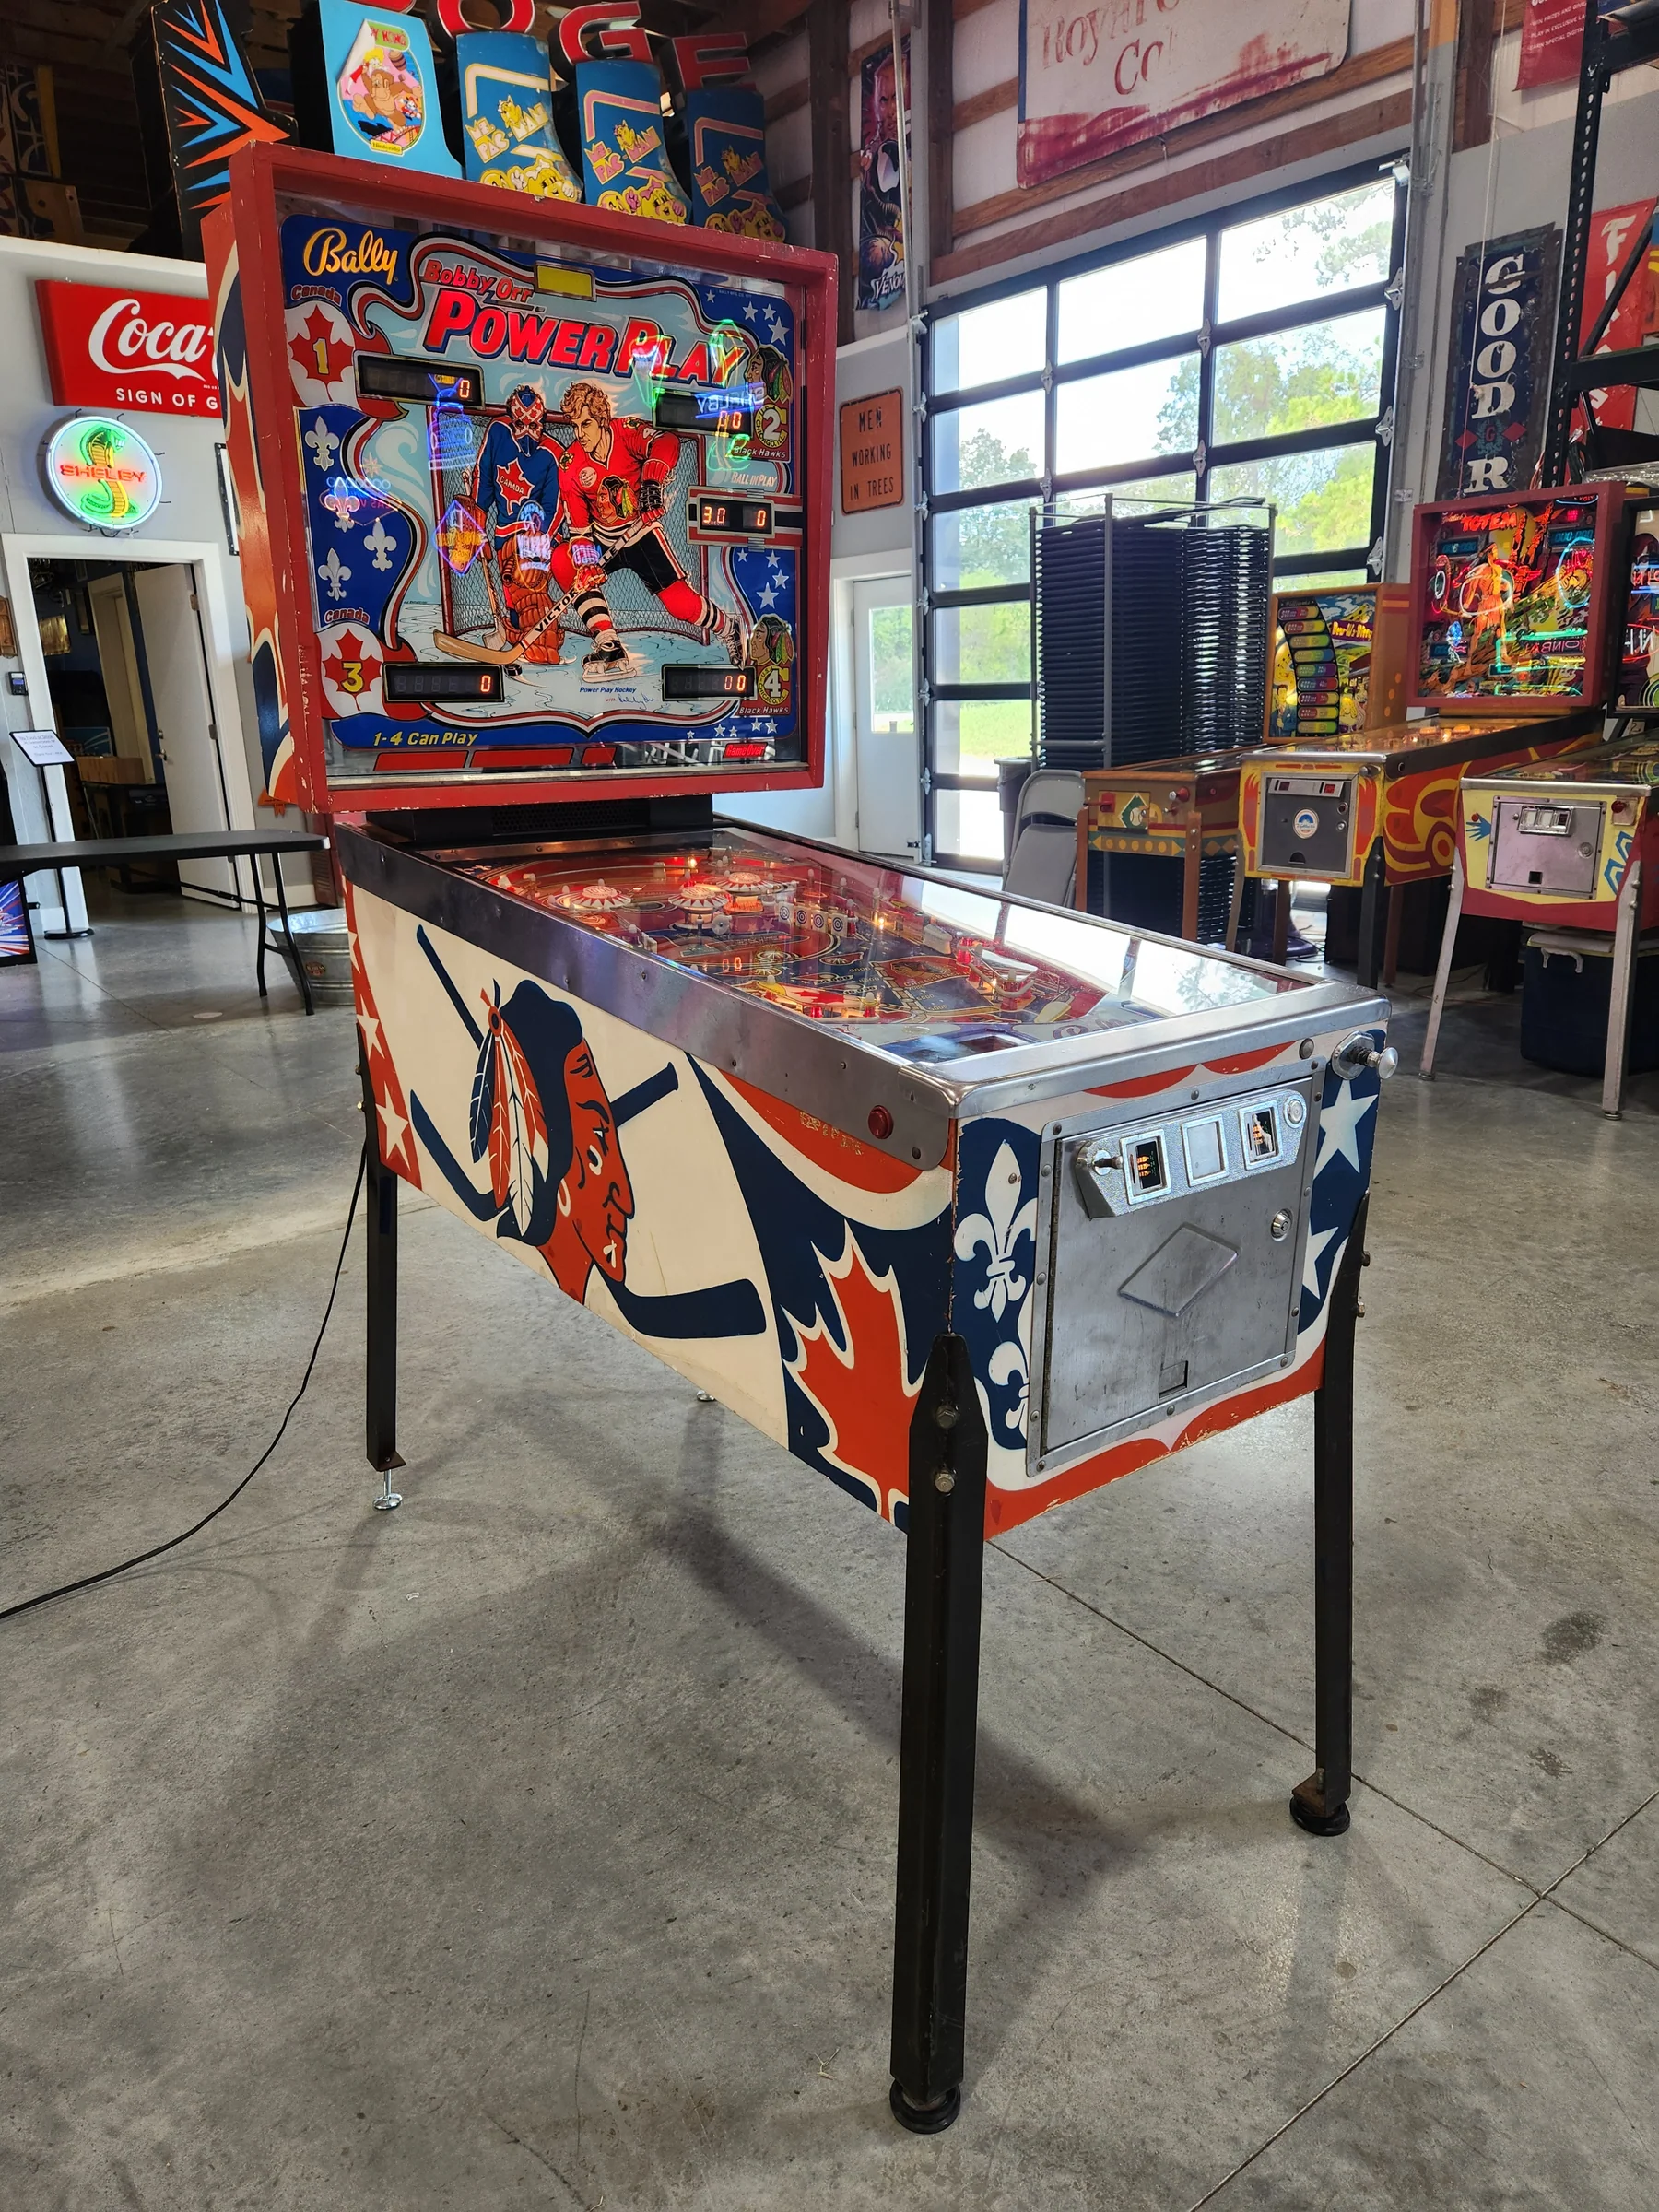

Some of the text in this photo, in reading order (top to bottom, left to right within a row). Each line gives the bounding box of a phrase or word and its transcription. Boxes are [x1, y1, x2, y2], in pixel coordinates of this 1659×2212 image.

[339, 0, 756, 90] OGE
[303, 228, 398, 285] Bally
[424, 260, 535, 302] Bobby Orr
[291, 284, 342, 306] Canada
[424, 288, 747, 387] POWER PLAY
[1471, 253, 1526, 419] GOOD
[313, 337, 329, 374] 1
[116, 387, 163, 405] SIGN
[172, 393, 196, 407] OF
[460, 380, 470, 398] 0
[762, 408, 782, 441] 2
[859, 406, 882, 433] MEN
[734, 445, 786, 458] Black Hawks
[852, 443, 891, 468] WORKING
[60, 464, 146, 483] SHELBY
[500, 475, 524, 495] CANADA
[731, 471, 778, 488] BALL IN PLAY
[850, 477, 894, 501] IN TREES
[324, 607, 370, 625] Canada
[342, 662, 364, 693] 3
[480, 675, 491, 693] 0
[764, 669, 782, 698] 4
[739, 706, 762, 714] Black
[406, 733, 439, 746] Can
[441, 733, 478, 747] Play
[726, 744, 764, 757] Game Over
